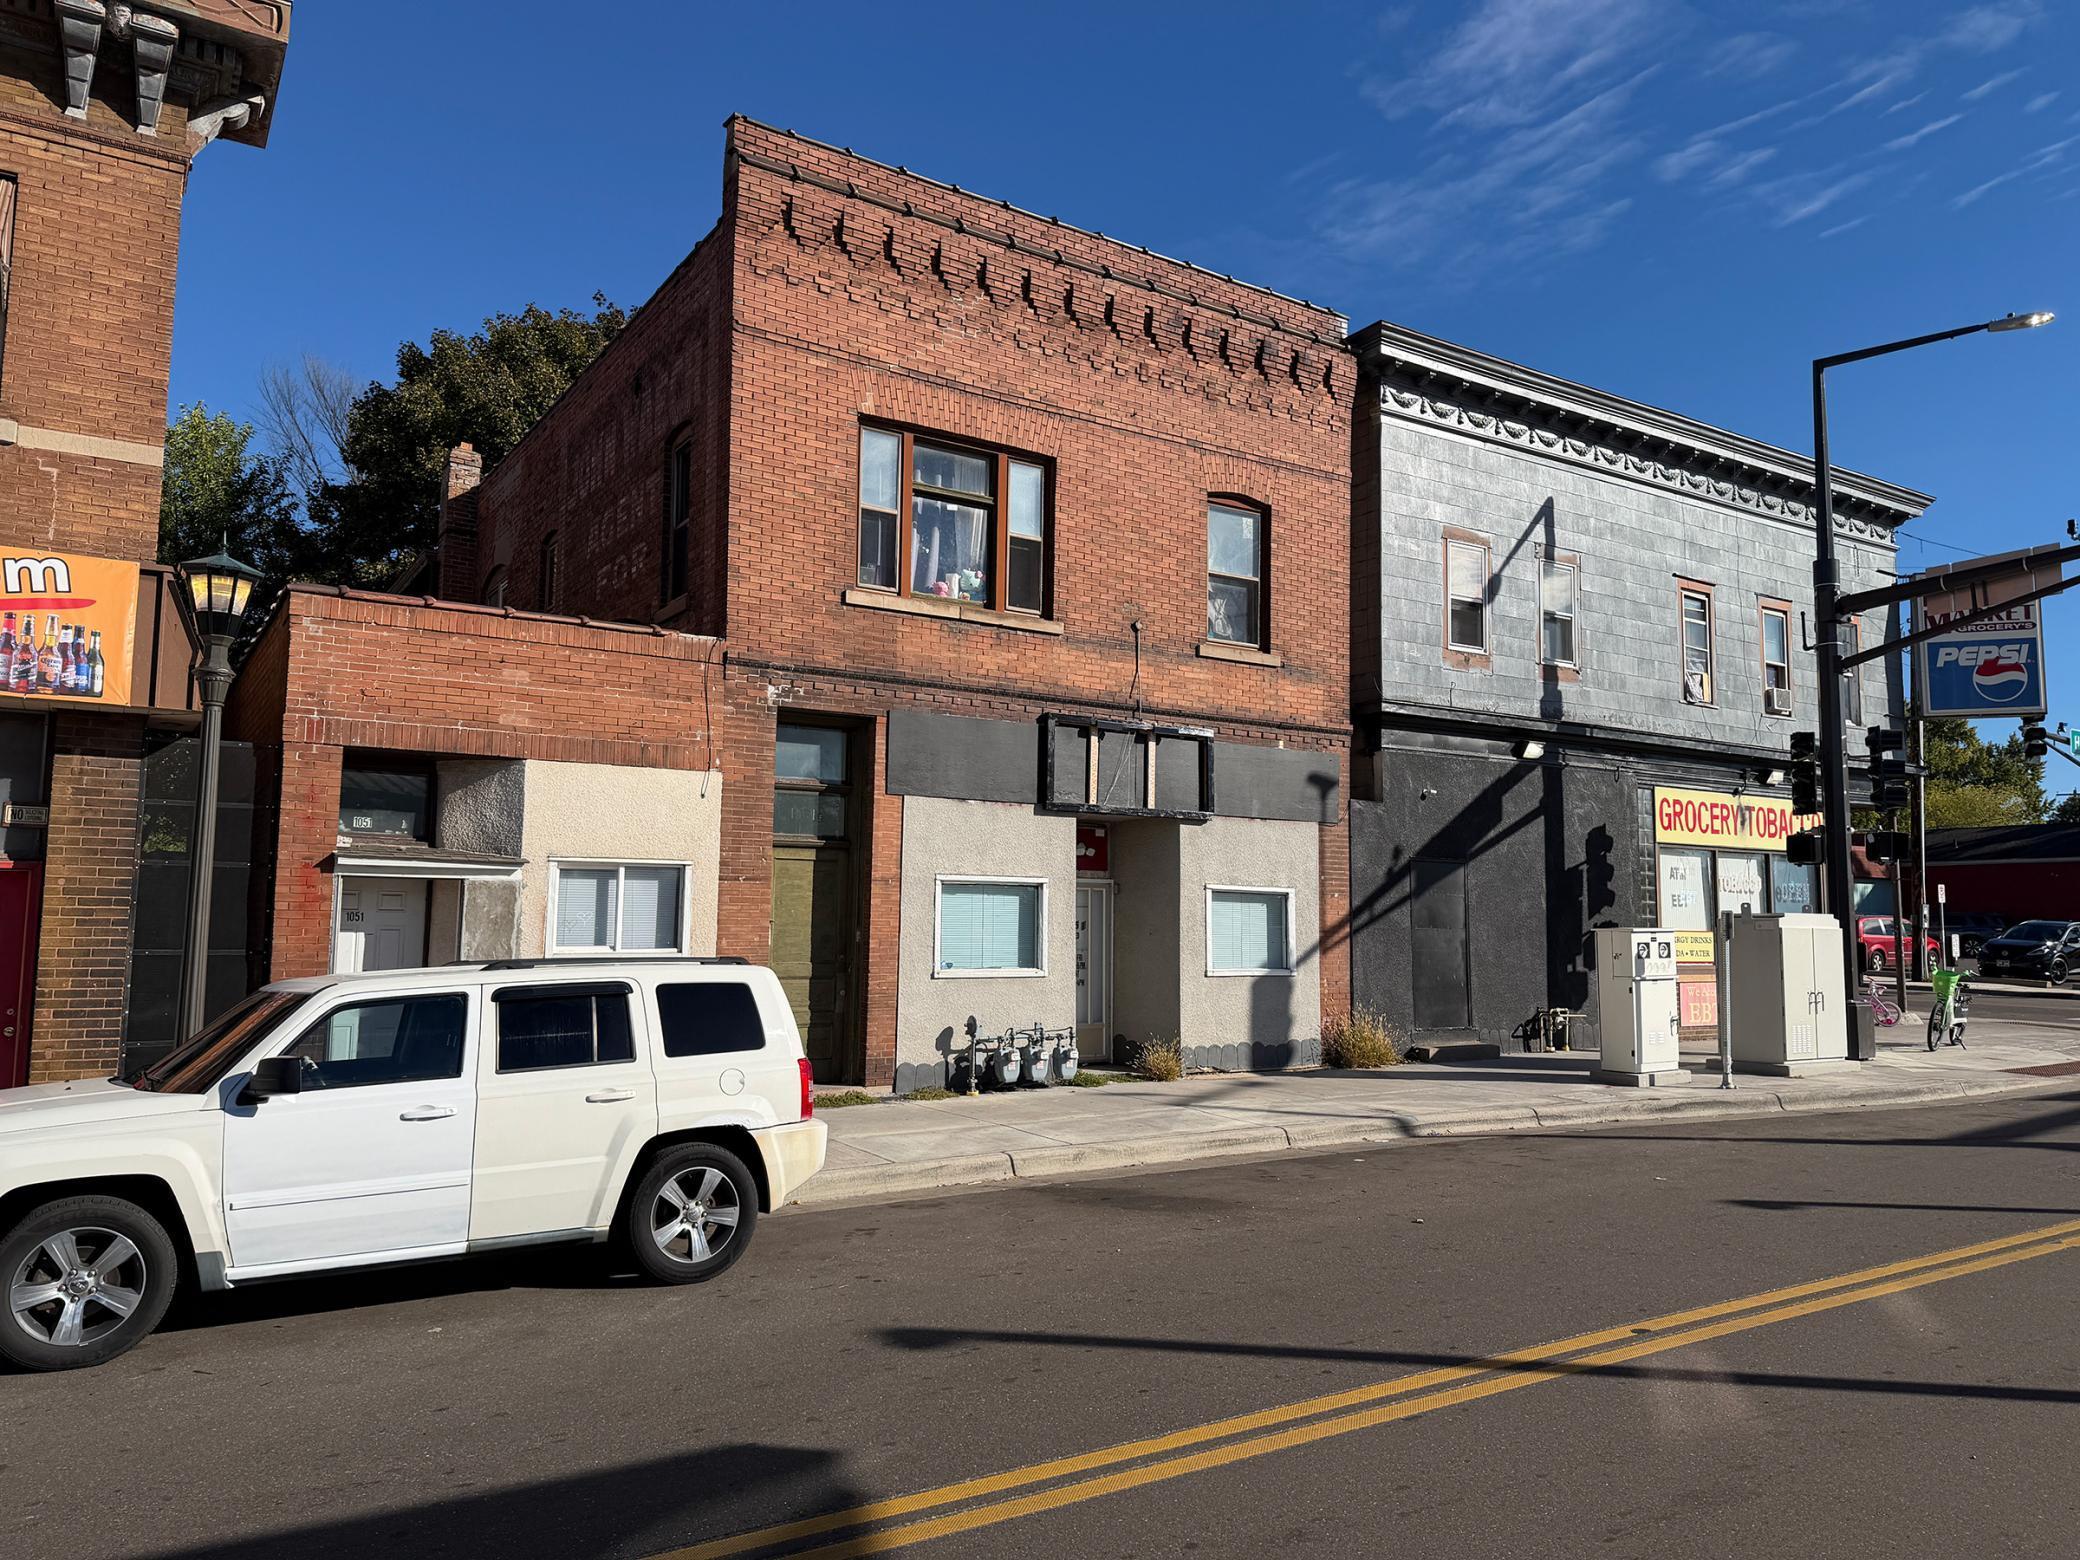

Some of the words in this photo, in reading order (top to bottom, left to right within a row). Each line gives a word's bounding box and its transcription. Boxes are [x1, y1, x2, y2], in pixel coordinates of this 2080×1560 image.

[1924, 603, 2035, 634] MAKET
[1958, 621, 2033, 633] GROCERY'S
[1936, 643, 2030, 668] PEPSI
[353, 816, 373, 828] 1051
[1659, 797, 1740, 837] GROCERY
[346, 911, 365, 922] 1051
[1690, 936, 1712, 944] DRINKS
[1689, 949, 1711, 957] WATER
